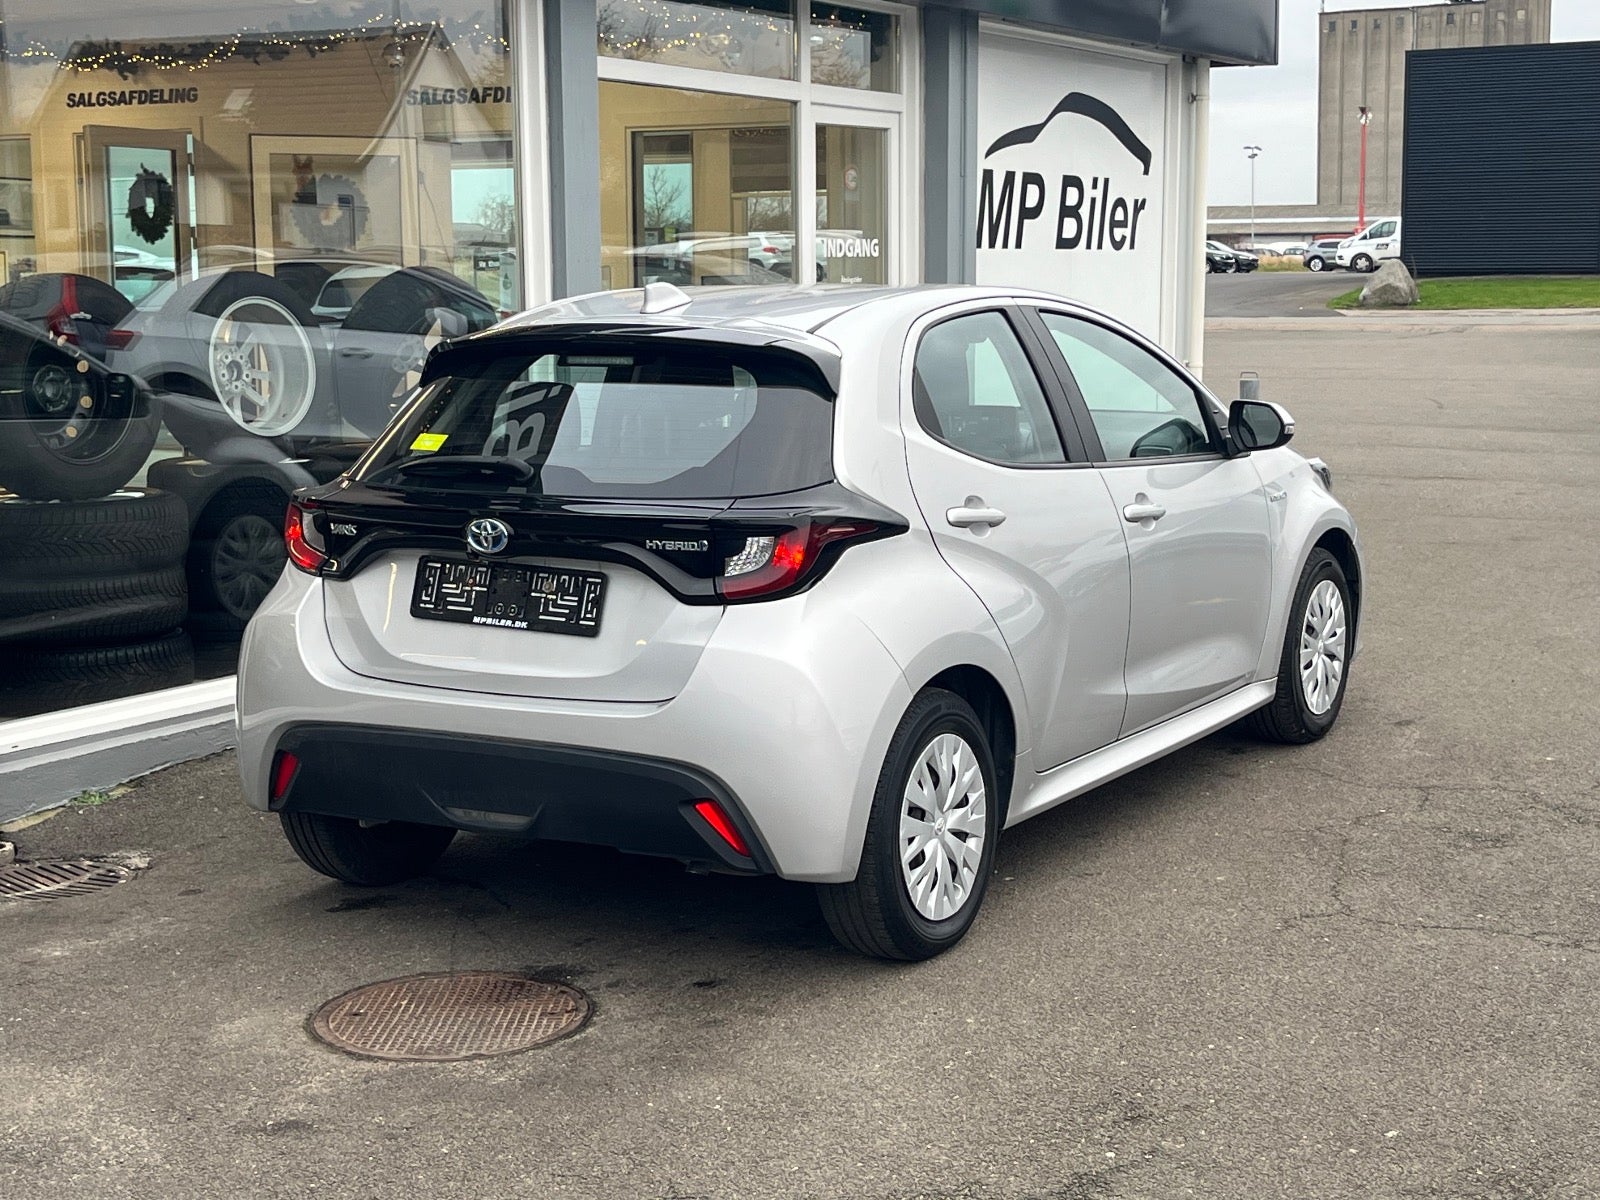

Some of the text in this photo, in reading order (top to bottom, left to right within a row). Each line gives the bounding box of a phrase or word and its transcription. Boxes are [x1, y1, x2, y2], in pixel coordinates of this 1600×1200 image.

[66, 87, 198, 108] SALGSAFDELING
[976, 169, 1147, 251] MP Biler
[823, 238, 880, 258] INDGANG
[645, 539, 699, 551] HYBRID
[472, 615, 529, 629] MPBILER.DK
